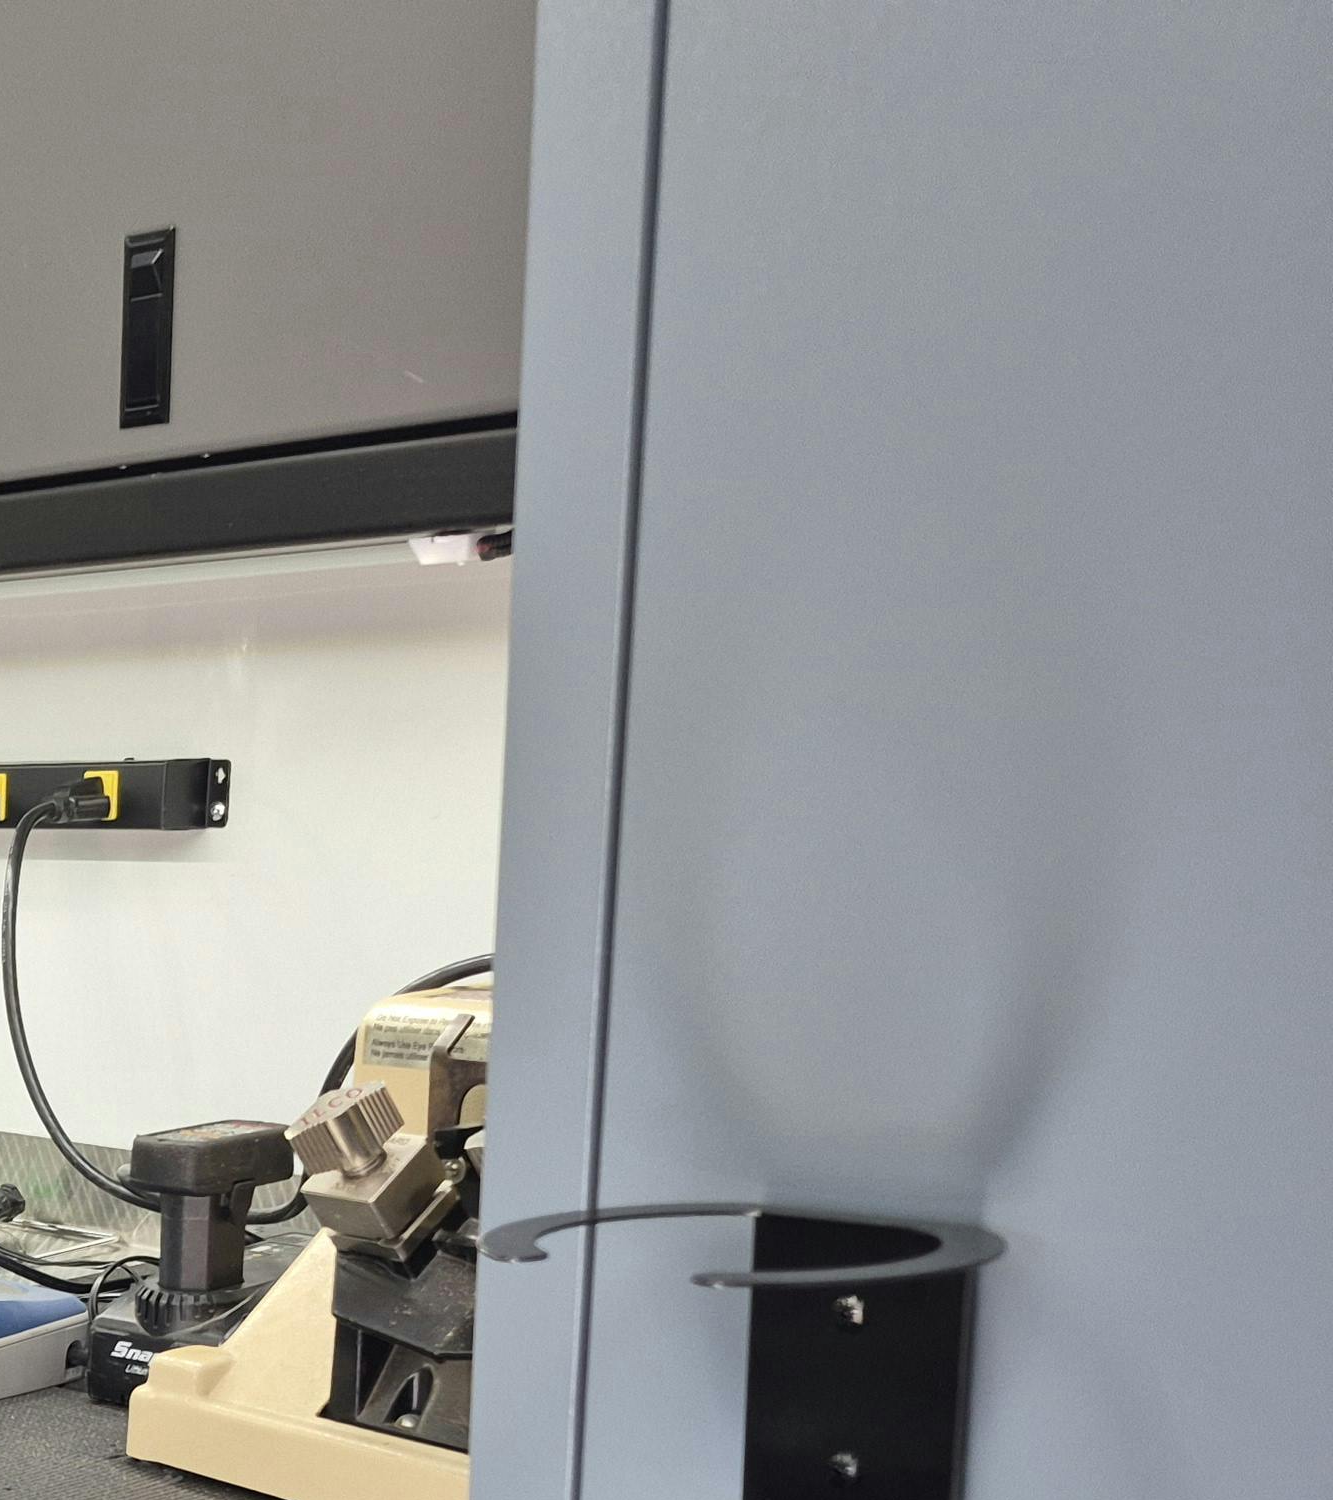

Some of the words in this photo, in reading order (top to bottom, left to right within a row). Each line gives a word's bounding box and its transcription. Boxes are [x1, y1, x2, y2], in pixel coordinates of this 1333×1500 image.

[413, 1041, 427, 1052] Eye
[299, 1086, 363, 1127] ILCO
[110, 1340, 153, 1363] Sna
